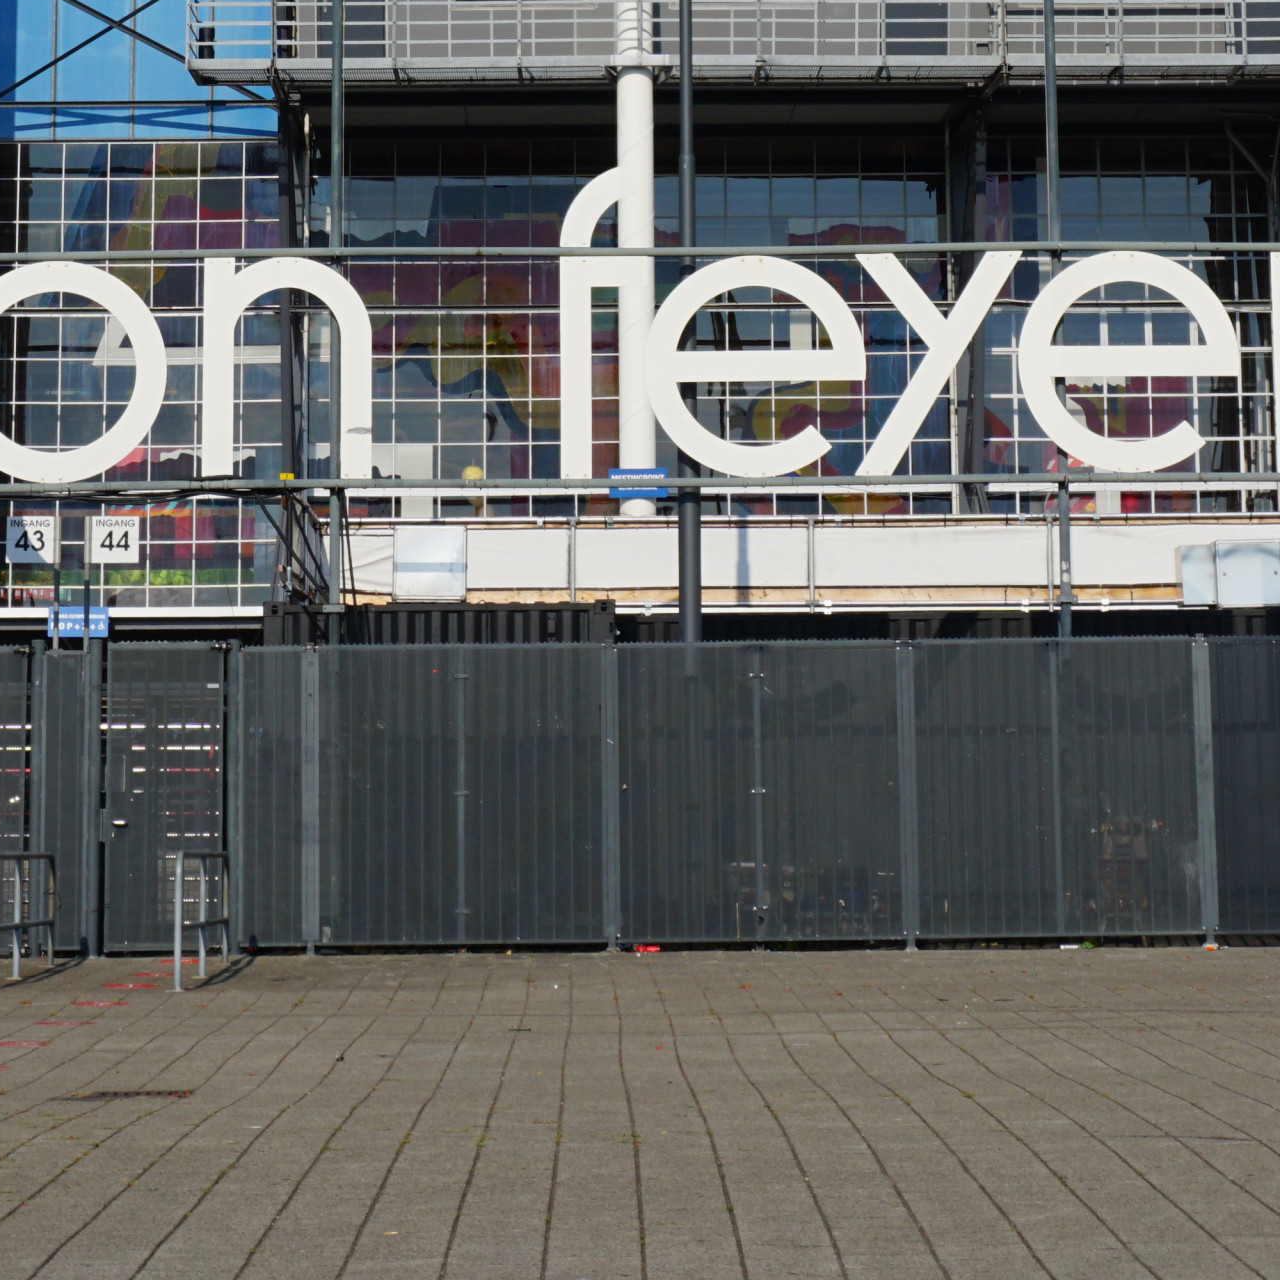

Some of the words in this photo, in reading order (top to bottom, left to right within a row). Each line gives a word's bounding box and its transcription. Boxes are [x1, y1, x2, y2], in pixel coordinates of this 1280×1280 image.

[10, 519, 51, 528] INGANG
[95, 519, 136, 528] INGANG
[14, 530, 46, 552] 43
[100, 530, 131, 551] 44
